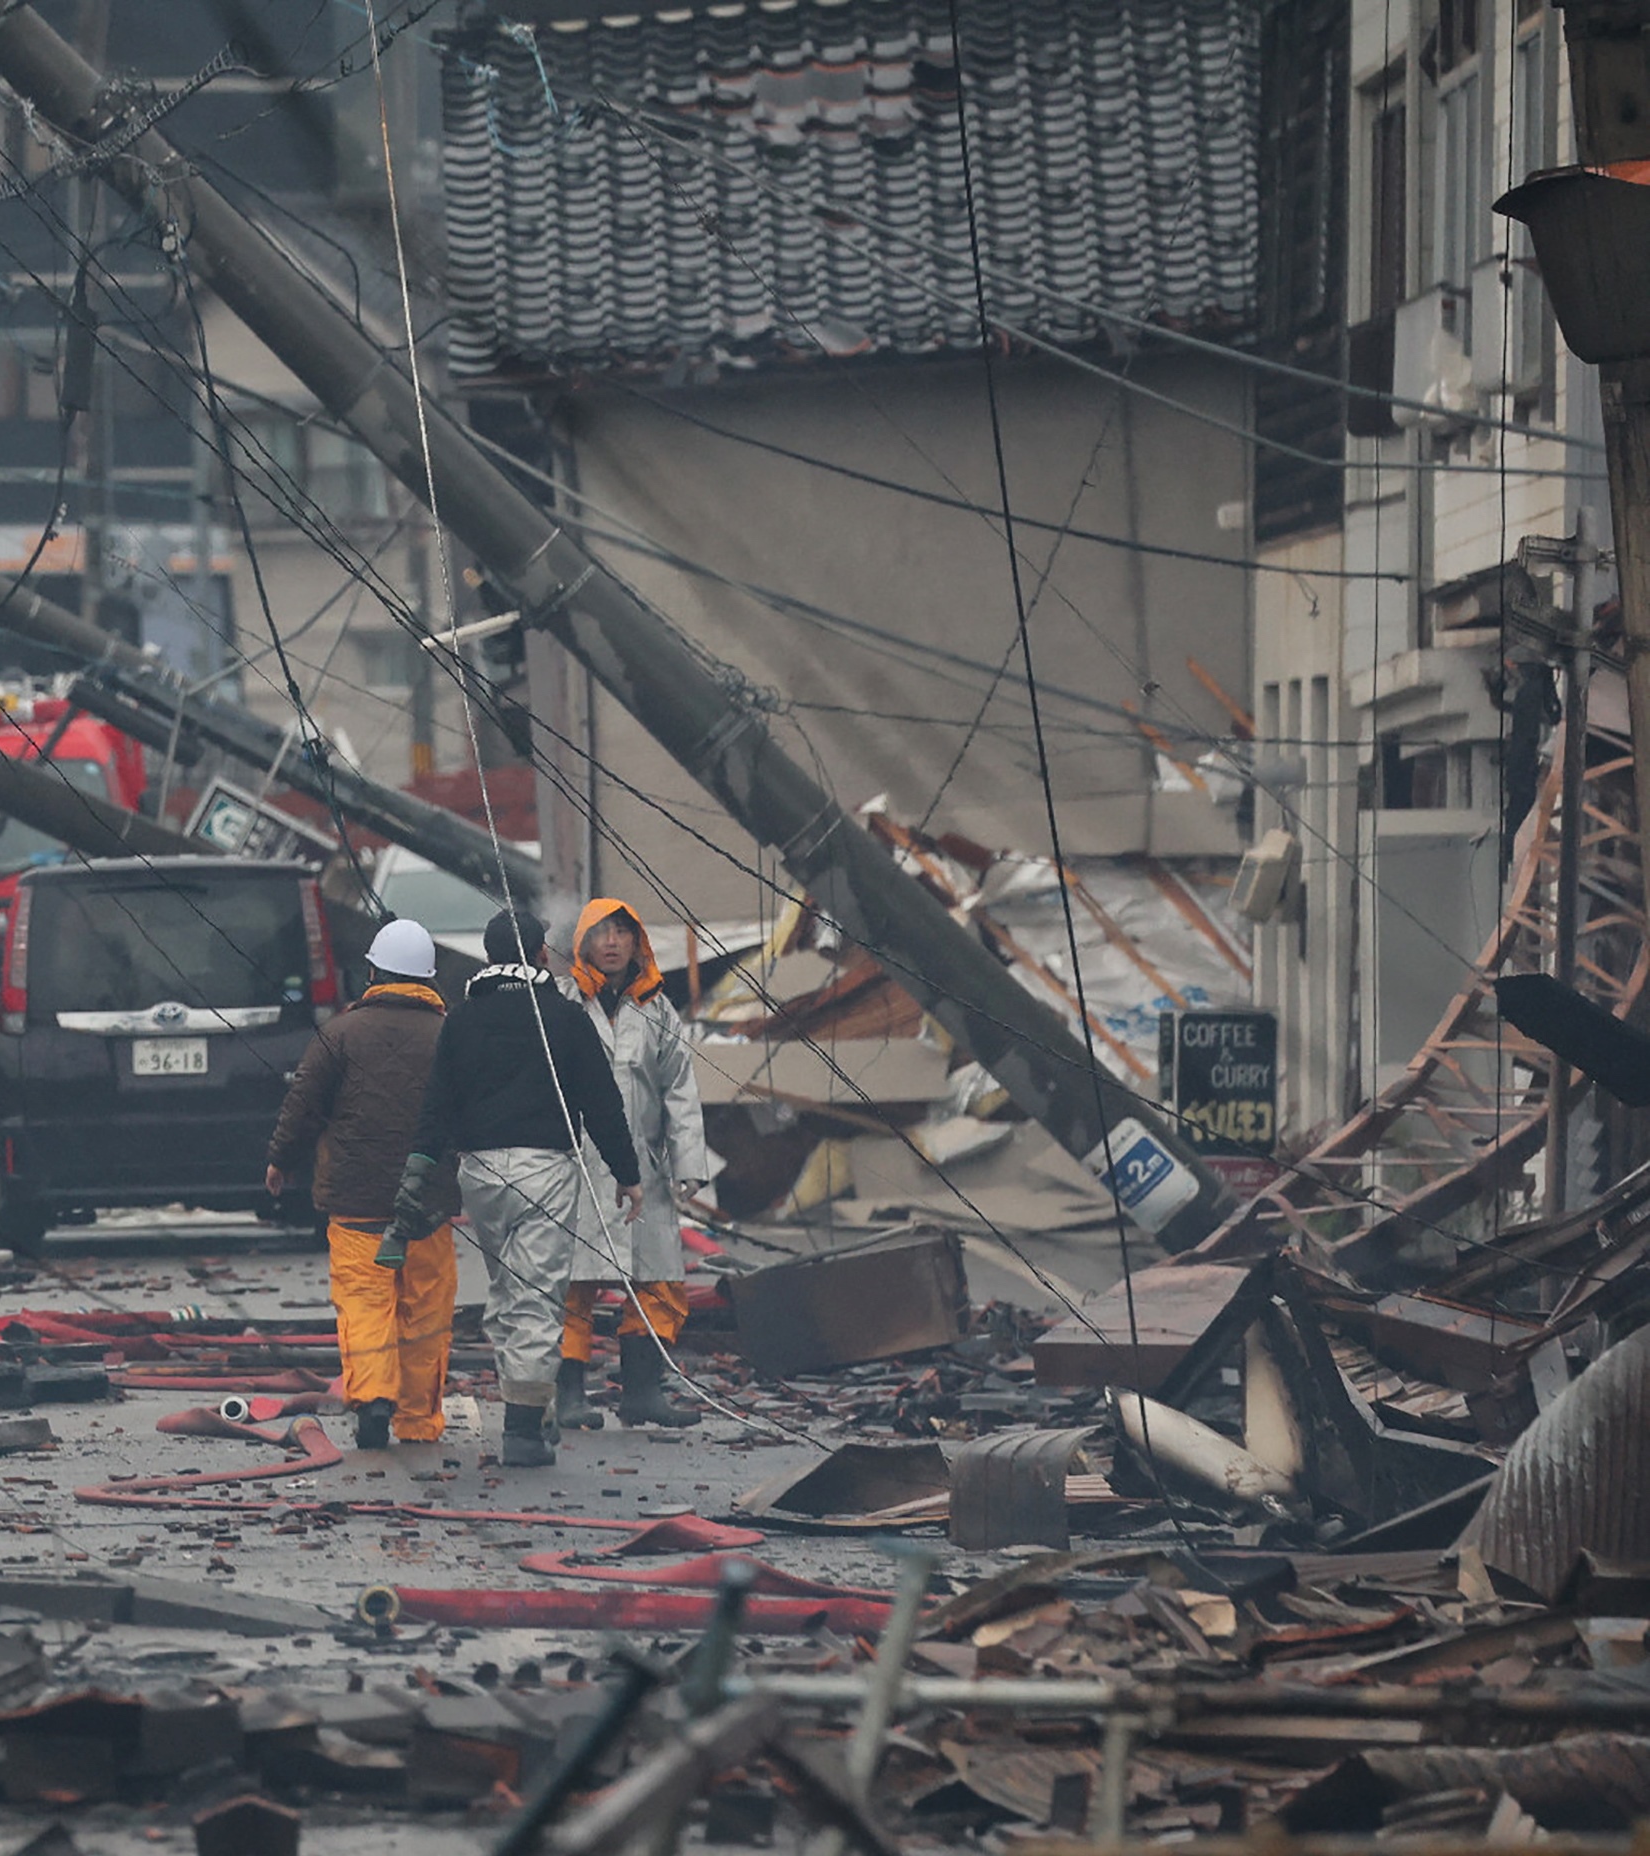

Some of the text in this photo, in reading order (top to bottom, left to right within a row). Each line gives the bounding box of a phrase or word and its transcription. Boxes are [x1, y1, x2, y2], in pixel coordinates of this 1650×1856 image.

[1183, 1022, 1257, 1048] COFFEE
[151, 1051, 204, 1071] 96-18
[1211, 1063, 1271, 1090] CURRY
